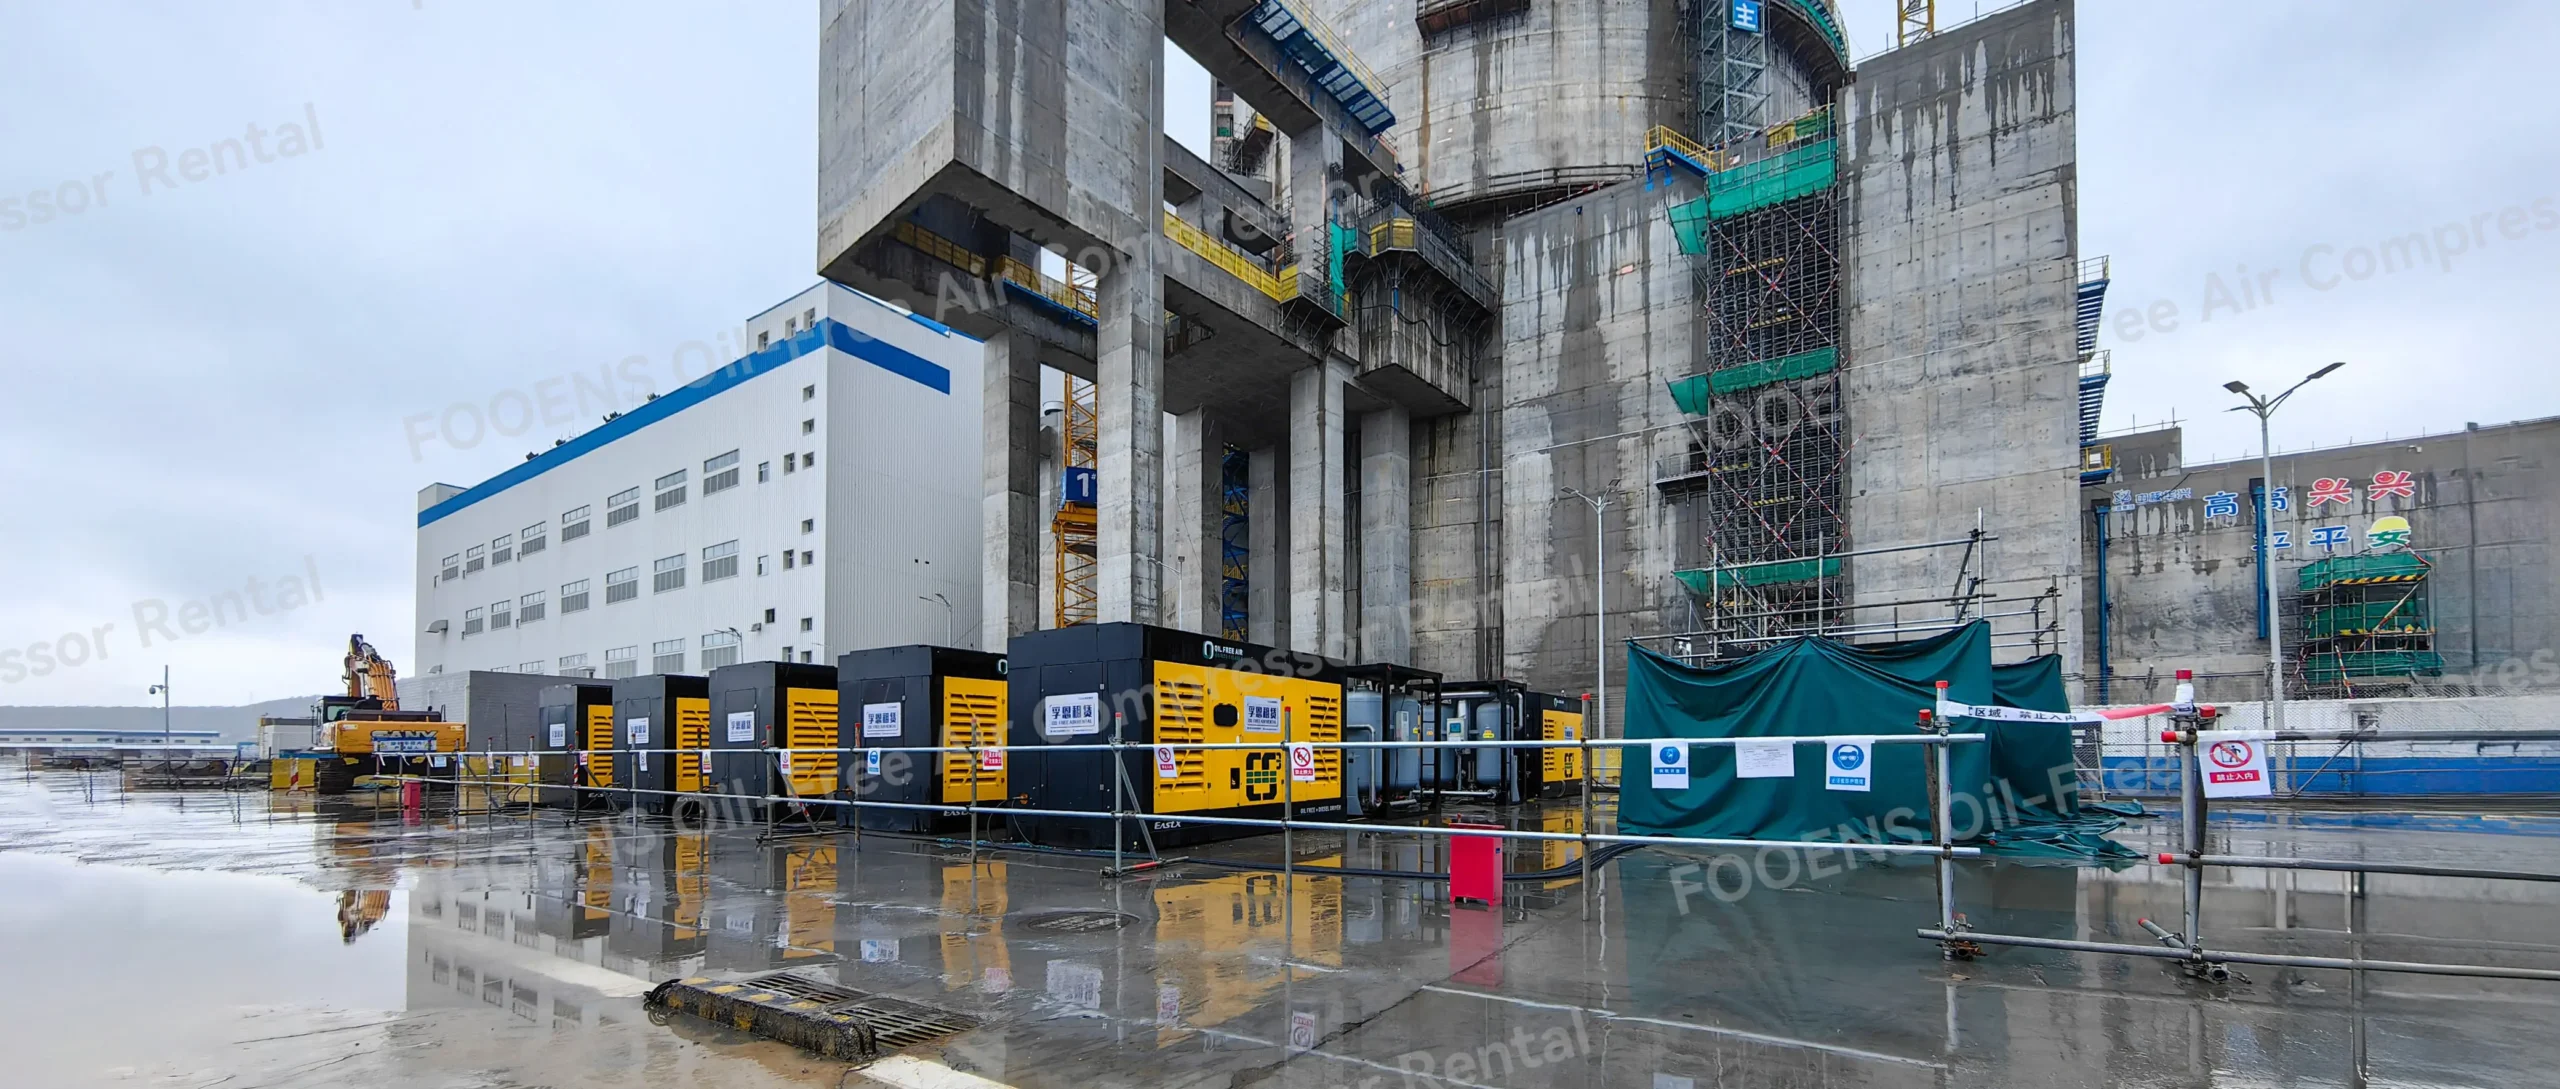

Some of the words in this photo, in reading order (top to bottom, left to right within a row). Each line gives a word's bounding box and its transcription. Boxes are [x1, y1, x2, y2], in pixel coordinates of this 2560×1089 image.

[1735, 3, 1756, 28] 主
[1222, 646, 1234, 655] FREE
[1235, 648, 1243, 656] AIR
[2217, 772, 2254, 781] 禁止入内
